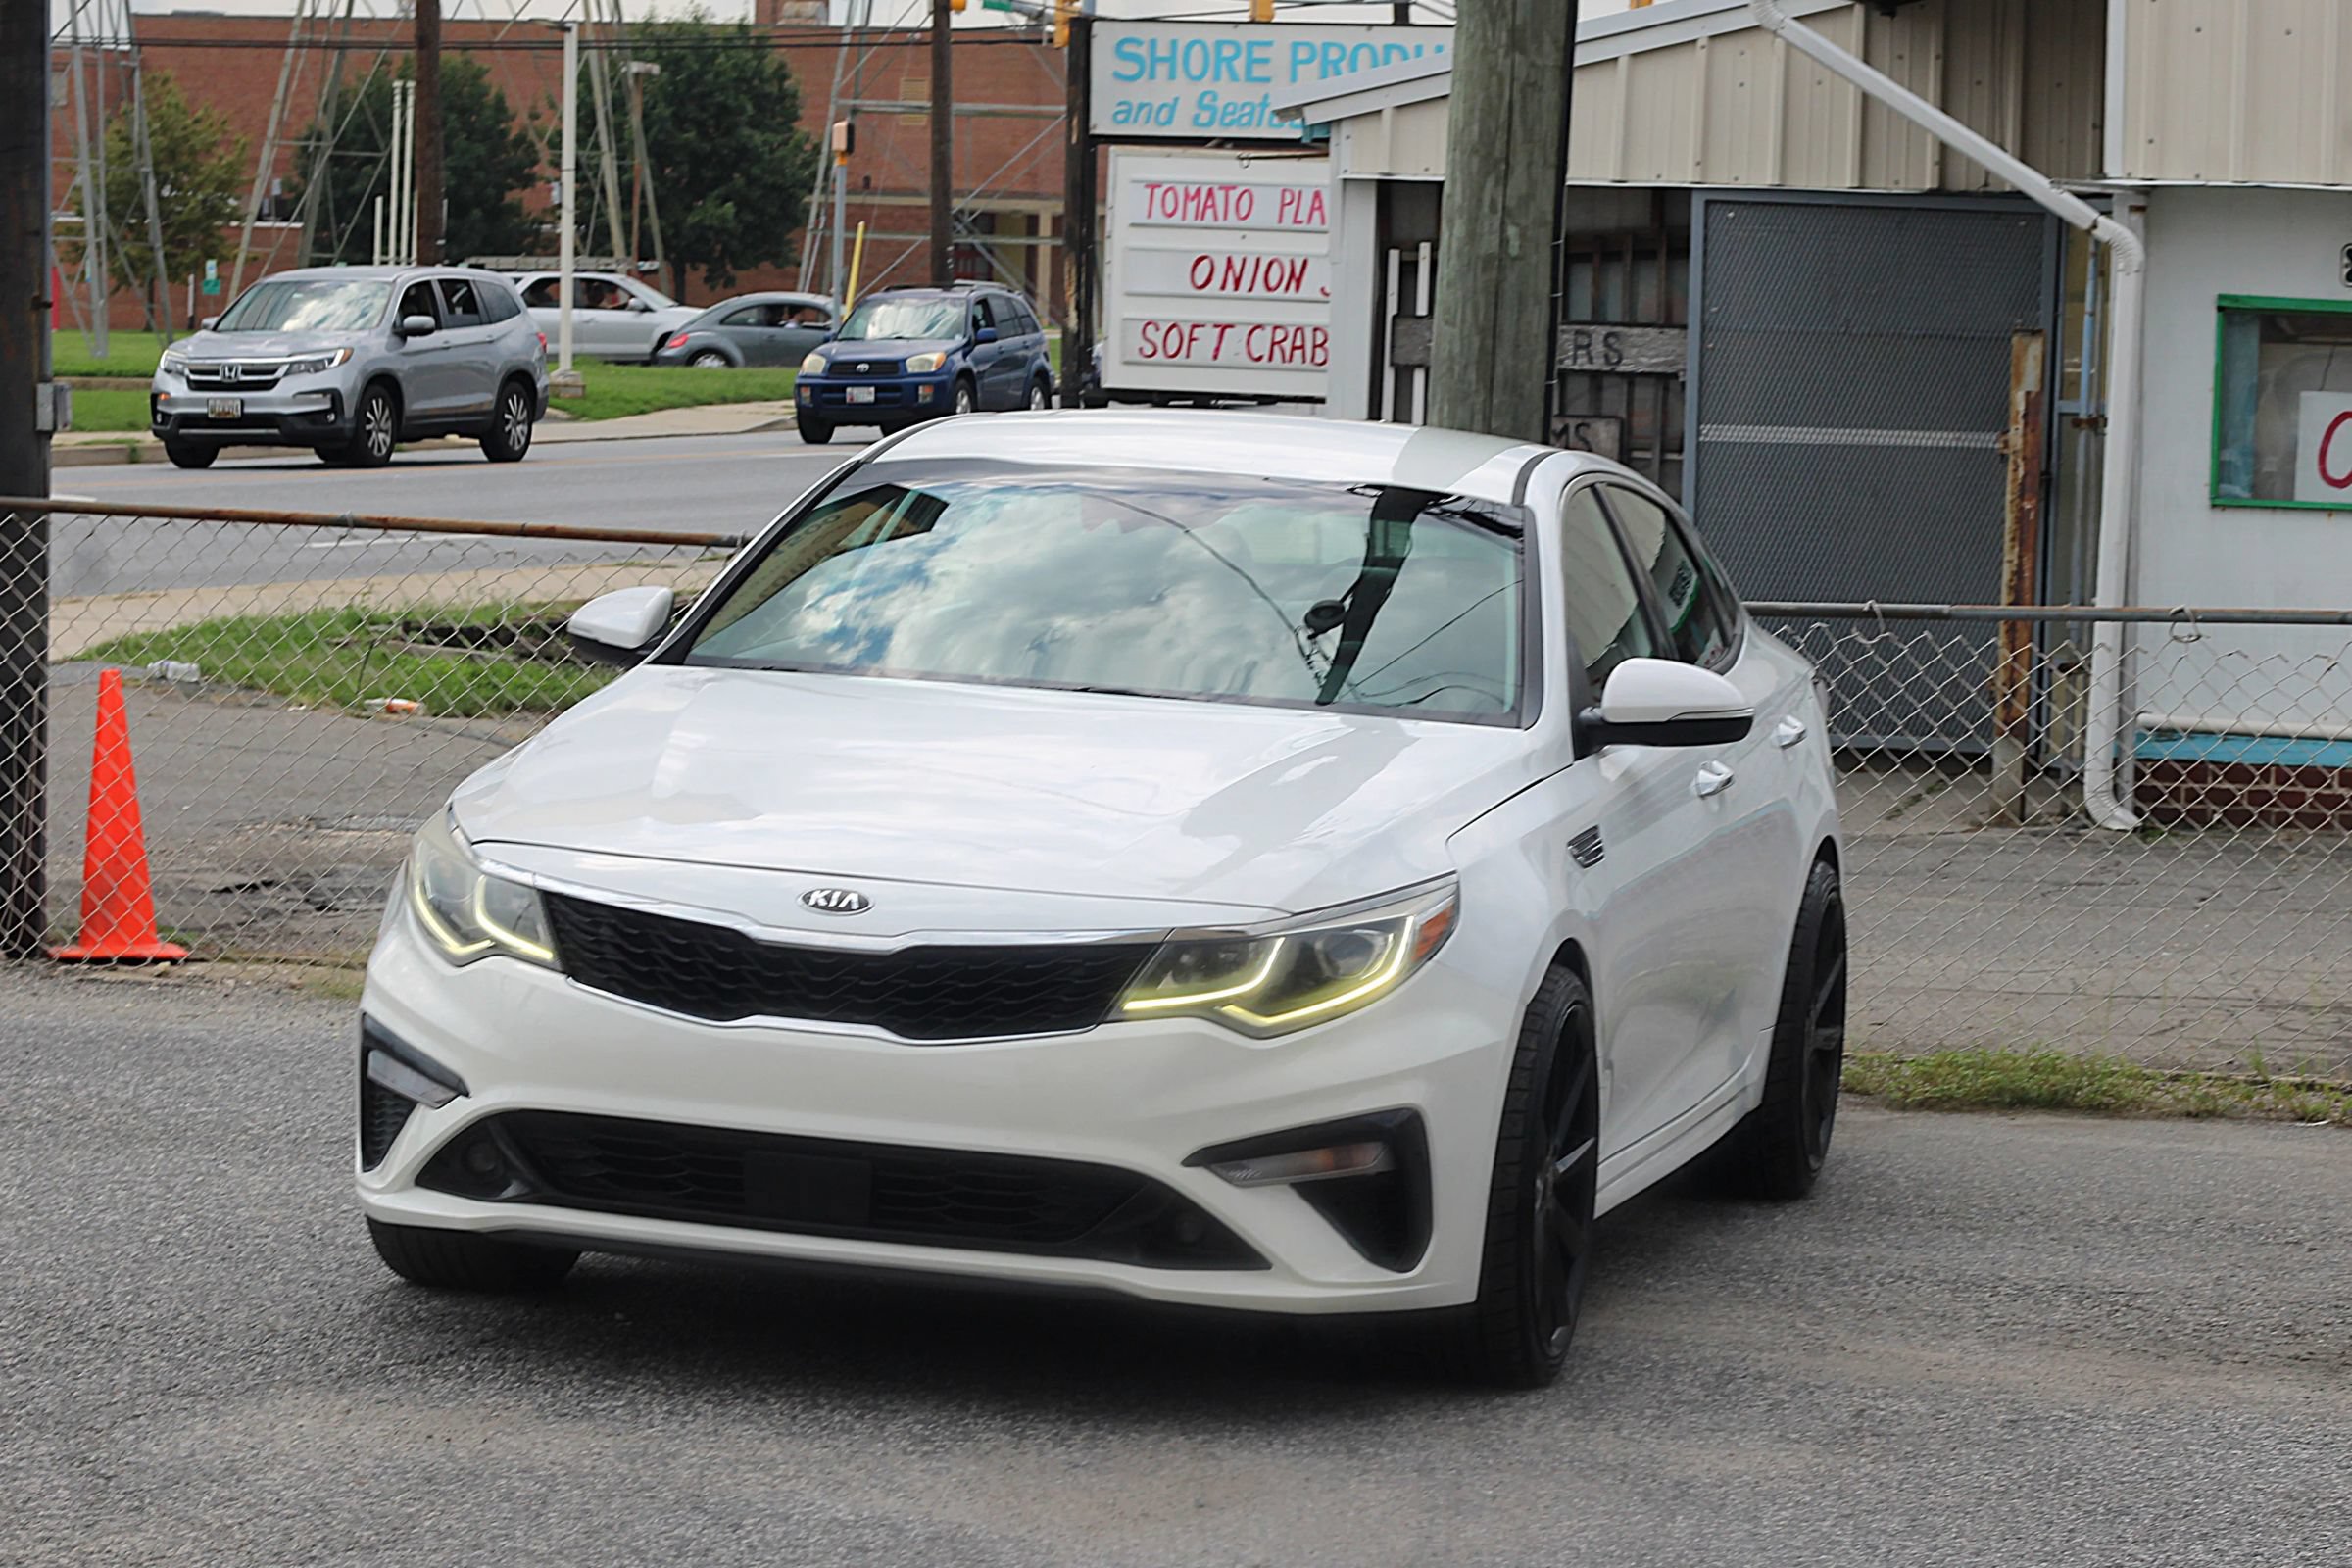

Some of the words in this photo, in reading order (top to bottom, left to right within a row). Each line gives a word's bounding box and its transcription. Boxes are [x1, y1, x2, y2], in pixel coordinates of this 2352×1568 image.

[1112, 36, 1275, 82] SHORE
[1112, 96, 1180, 126] and
[1144, 184, 1254, 221] TOMATO
[1277, 187, 1326, 225] PLA
[1190, 254, 1308, 293] ONION
[1139, 320, 1235, 361] SOFT
[1246, 324, 1329, 367] CRAB
[808, 889, 860, 910] KIA
